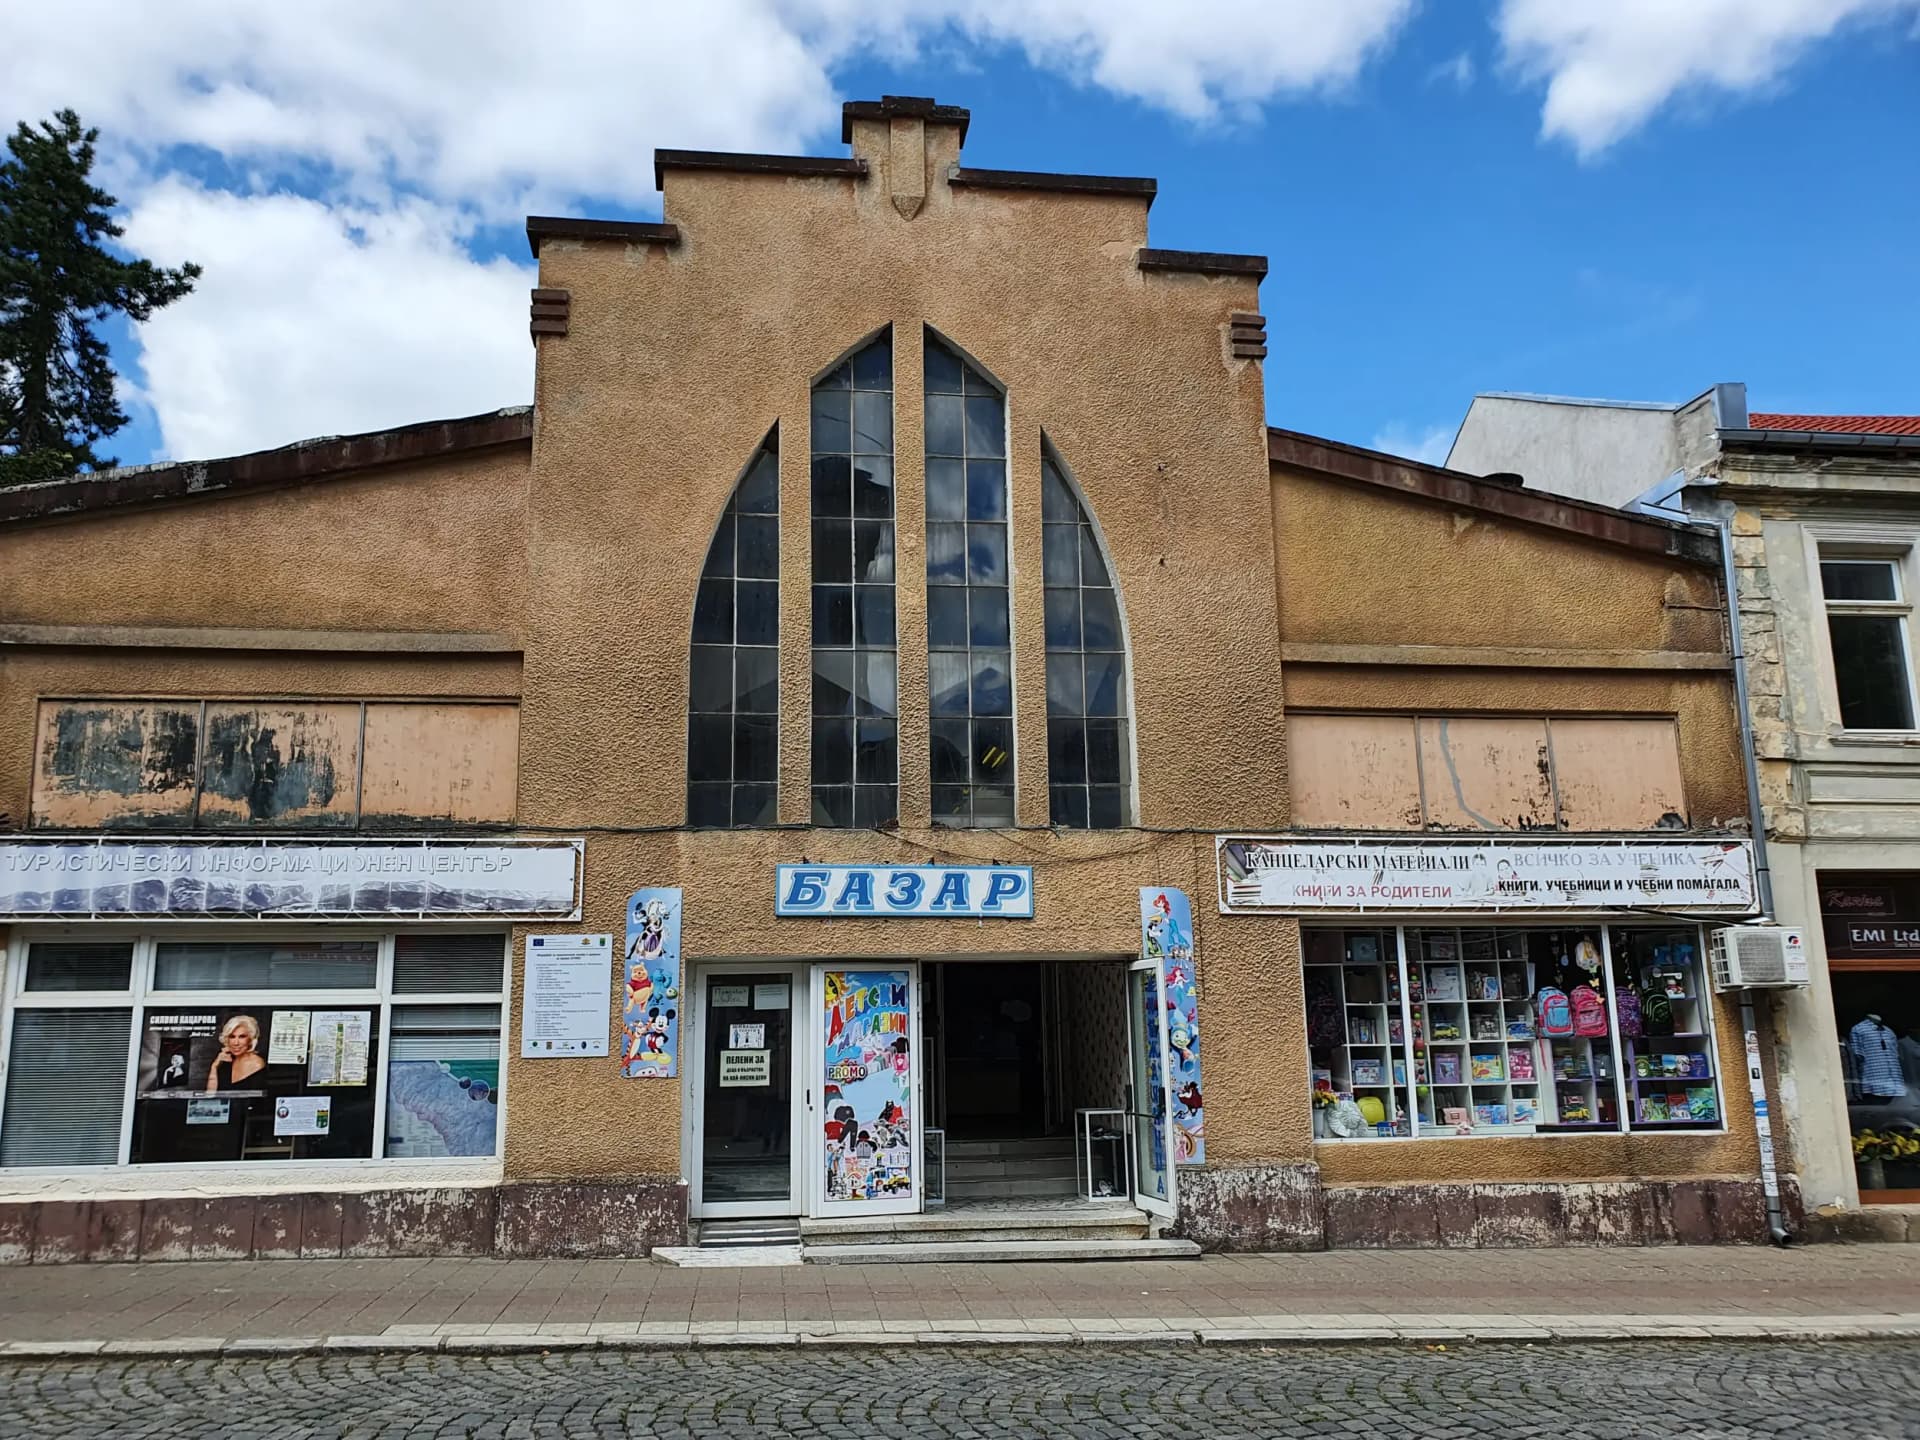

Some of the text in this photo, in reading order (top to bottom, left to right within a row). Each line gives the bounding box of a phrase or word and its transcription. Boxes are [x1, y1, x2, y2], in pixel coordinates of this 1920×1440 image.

[6, 854, 193, 872] ТУРИСТИЧЕСКИ
[419, 854, 513, 875] ЦЕНТЪР
[1246, 853, 1470, 870] КАНЦЕЛАРСКИ МАТЕРИАЛИ
[1514, 852, 1697, 866] ВСИЧКО ЗА УЧЕНИКА
[783, 870, 1026, 910] БАЗАР
[1293, 885, 1452, 898] КНИГИ ЗА РОДИТЕЛИ
[1546, 880, 1611, 892] УЧЕБНИЦИ
[1614, 880, 1623, 891] И
[1628, 879, 1673, 891] УЧЕБНИ
[1677, 879, 1741, 890] ПОМАГАЛА
[1851, 929, 1886, 942] EMI
[828, 983, 906, 1047] ДЕТСКИ
[836, 1011, 906, 1056] МАГАЗИН
[726, 1055, 765, 1064] ПЕЛЕНИ ЗА
[828, 1065, 867, 1080] PROMO
